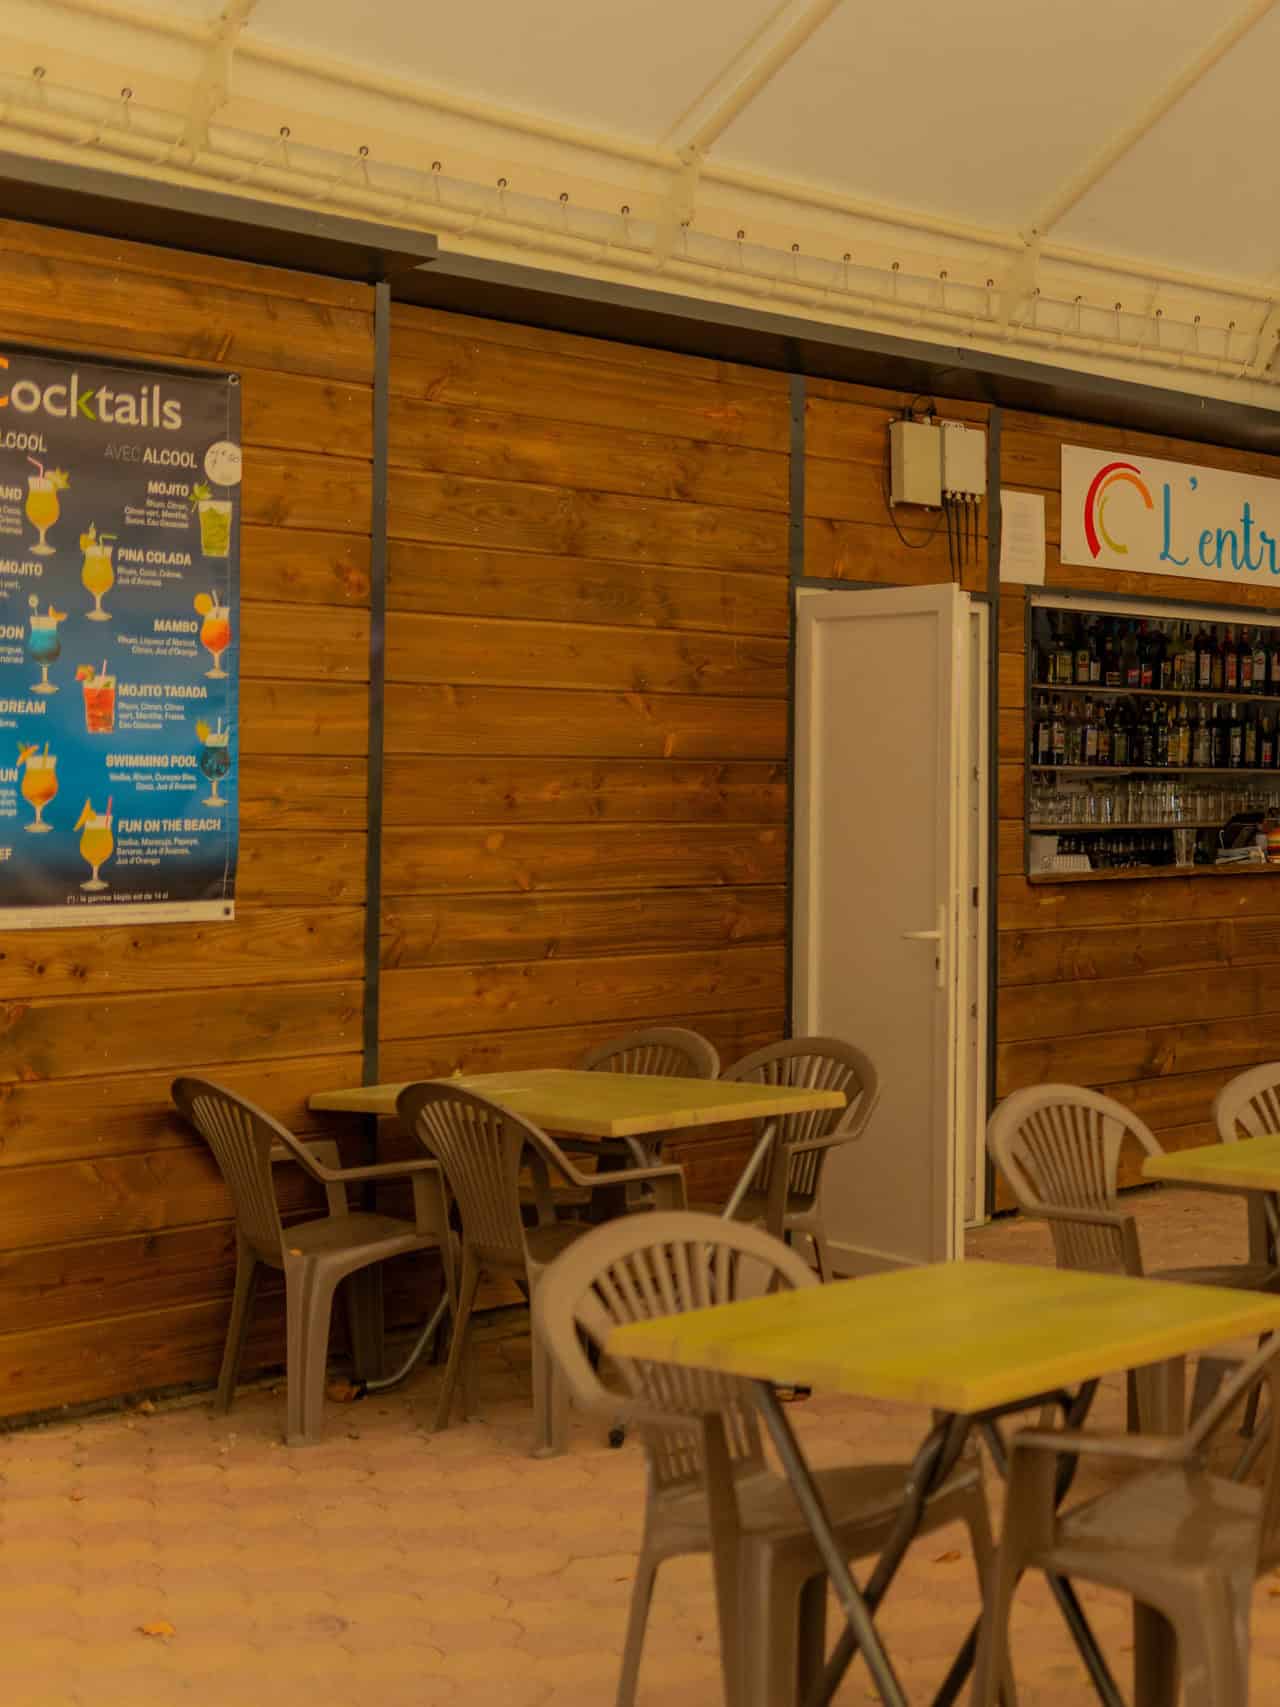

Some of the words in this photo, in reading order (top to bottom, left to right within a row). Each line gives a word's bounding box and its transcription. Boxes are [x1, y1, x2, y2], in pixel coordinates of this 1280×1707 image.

[0, 356, 183, 430] ocktails
[0, 430, 48, 453] LCOOL
[143, 449, 198, 469] ALCOOL
[148, 481, 189, 497] MOJITO
[117, 548, 144, 562] PINA
[146, 550, 192, 567] COLADA
[154, 619, 199, 633] MAMBO
[118, 684, 162, 698] MOJITO
[105, 754, 169, 768] SWIMMING
[170, 755, 198, 768] POOL
[118, 819, 142, 833] FUN
[161, 819, 182, 832] THE
[184, 818, 221, 831] BEACH
